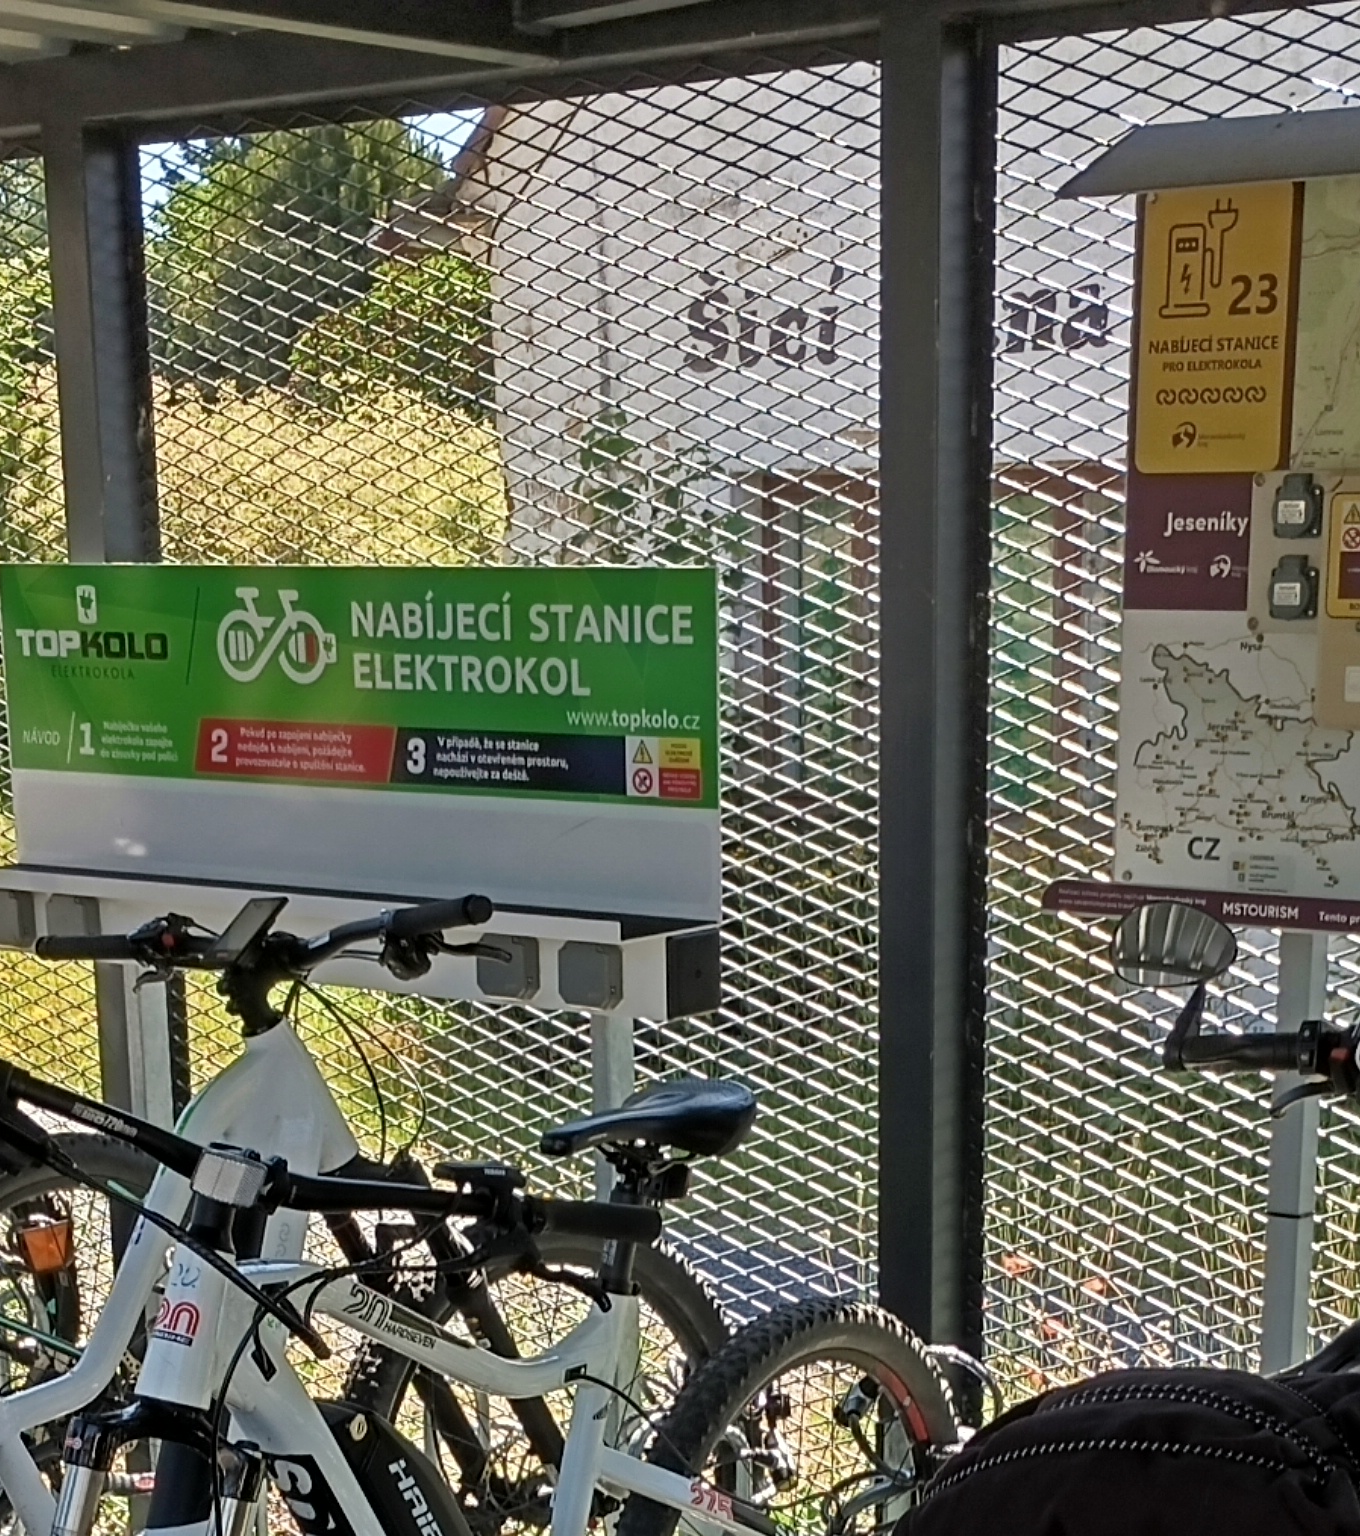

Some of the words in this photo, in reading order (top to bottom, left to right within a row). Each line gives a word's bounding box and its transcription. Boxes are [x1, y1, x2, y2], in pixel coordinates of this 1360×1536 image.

[1228, 273, 1279, 316] 23
[1148, 334, 1213, 354] NABÍJECÍ
[1217, 335, 1280, 352] STANICE
[1162, 361, 1184, 373] PRO
[1187, 358, 1263, 372] ELEKTROKOLA
[1163, 511, 1249, 537] Jeseníky
[350, 590, 511, 642] NABÍJECÍ
[529, 604, 694, 645] STANICE
[16, 629, 169, 660] TOPKOLO
[51, 665, 135, 680] ELEKTROKOLA
[353, 652, 591, 697] ELEKTROKOL
[566, 708, 701, 732] www.topkolo.cz
[23, 726, 61, 746] NÁVOD
[79, 722, 96, 755] 1
[211, 728, 228, 762] 2
[437, 735, 446, 748] V
[507, 738, 540, 752] stanice
[406, 738, 426, 774] 3
[1187, 837, 1221, 861] CZ
[1223, 903, 1299, 919] MSTOURISM
[1319, 911, 1347, 923] Tento
